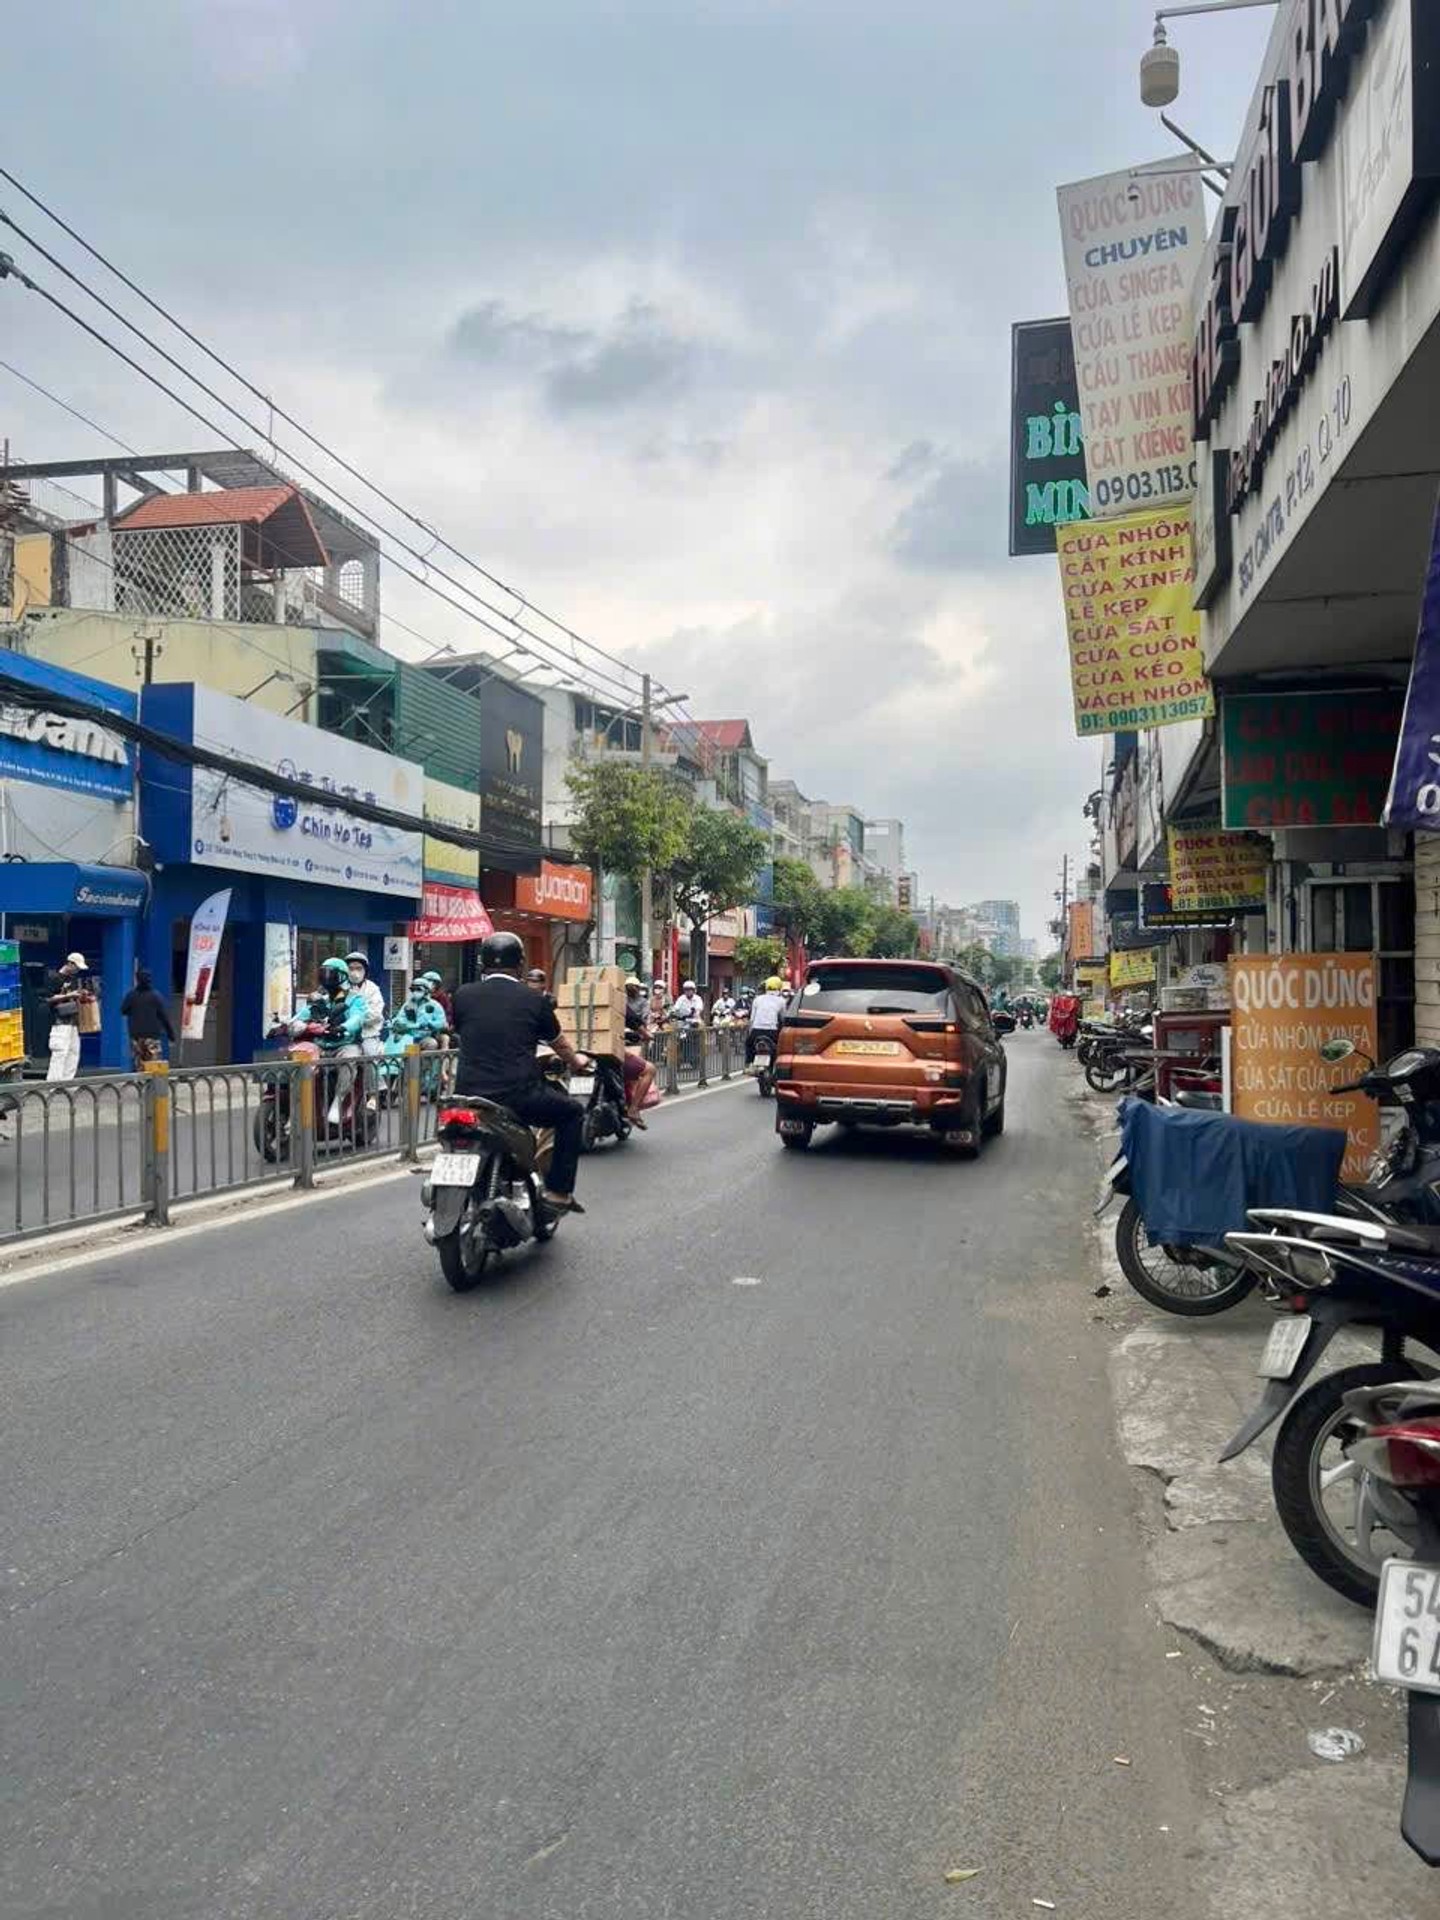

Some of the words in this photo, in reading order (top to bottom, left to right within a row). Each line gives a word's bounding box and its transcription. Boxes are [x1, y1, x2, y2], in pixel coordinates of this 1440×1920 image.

[1085, 226, 1188, 268] CHUYÊN
[1119, 262, 1184, 300] SINGFA
[1119, 520, 1191, 546] NHÔM
[1120, 546, 1185, 568] KÍNH
[1143, 677, 1211, 701] NHÔM
[1109, 697, 1208, 727] 0903113057
[1233, 957, 1299, 1014] QUỐC
[1305, 959, 1373, 1009] DŨNG
[1236, 1019, 1268, 1050] CỬA
[1273, 1021, 1321, 1050] NHÔM
[1236, 1059, 1268, 1091] CỬA
[1296, 1060, 1327, 1092] CỬA
[1254, 1098, 1292, 1118] CỬA
